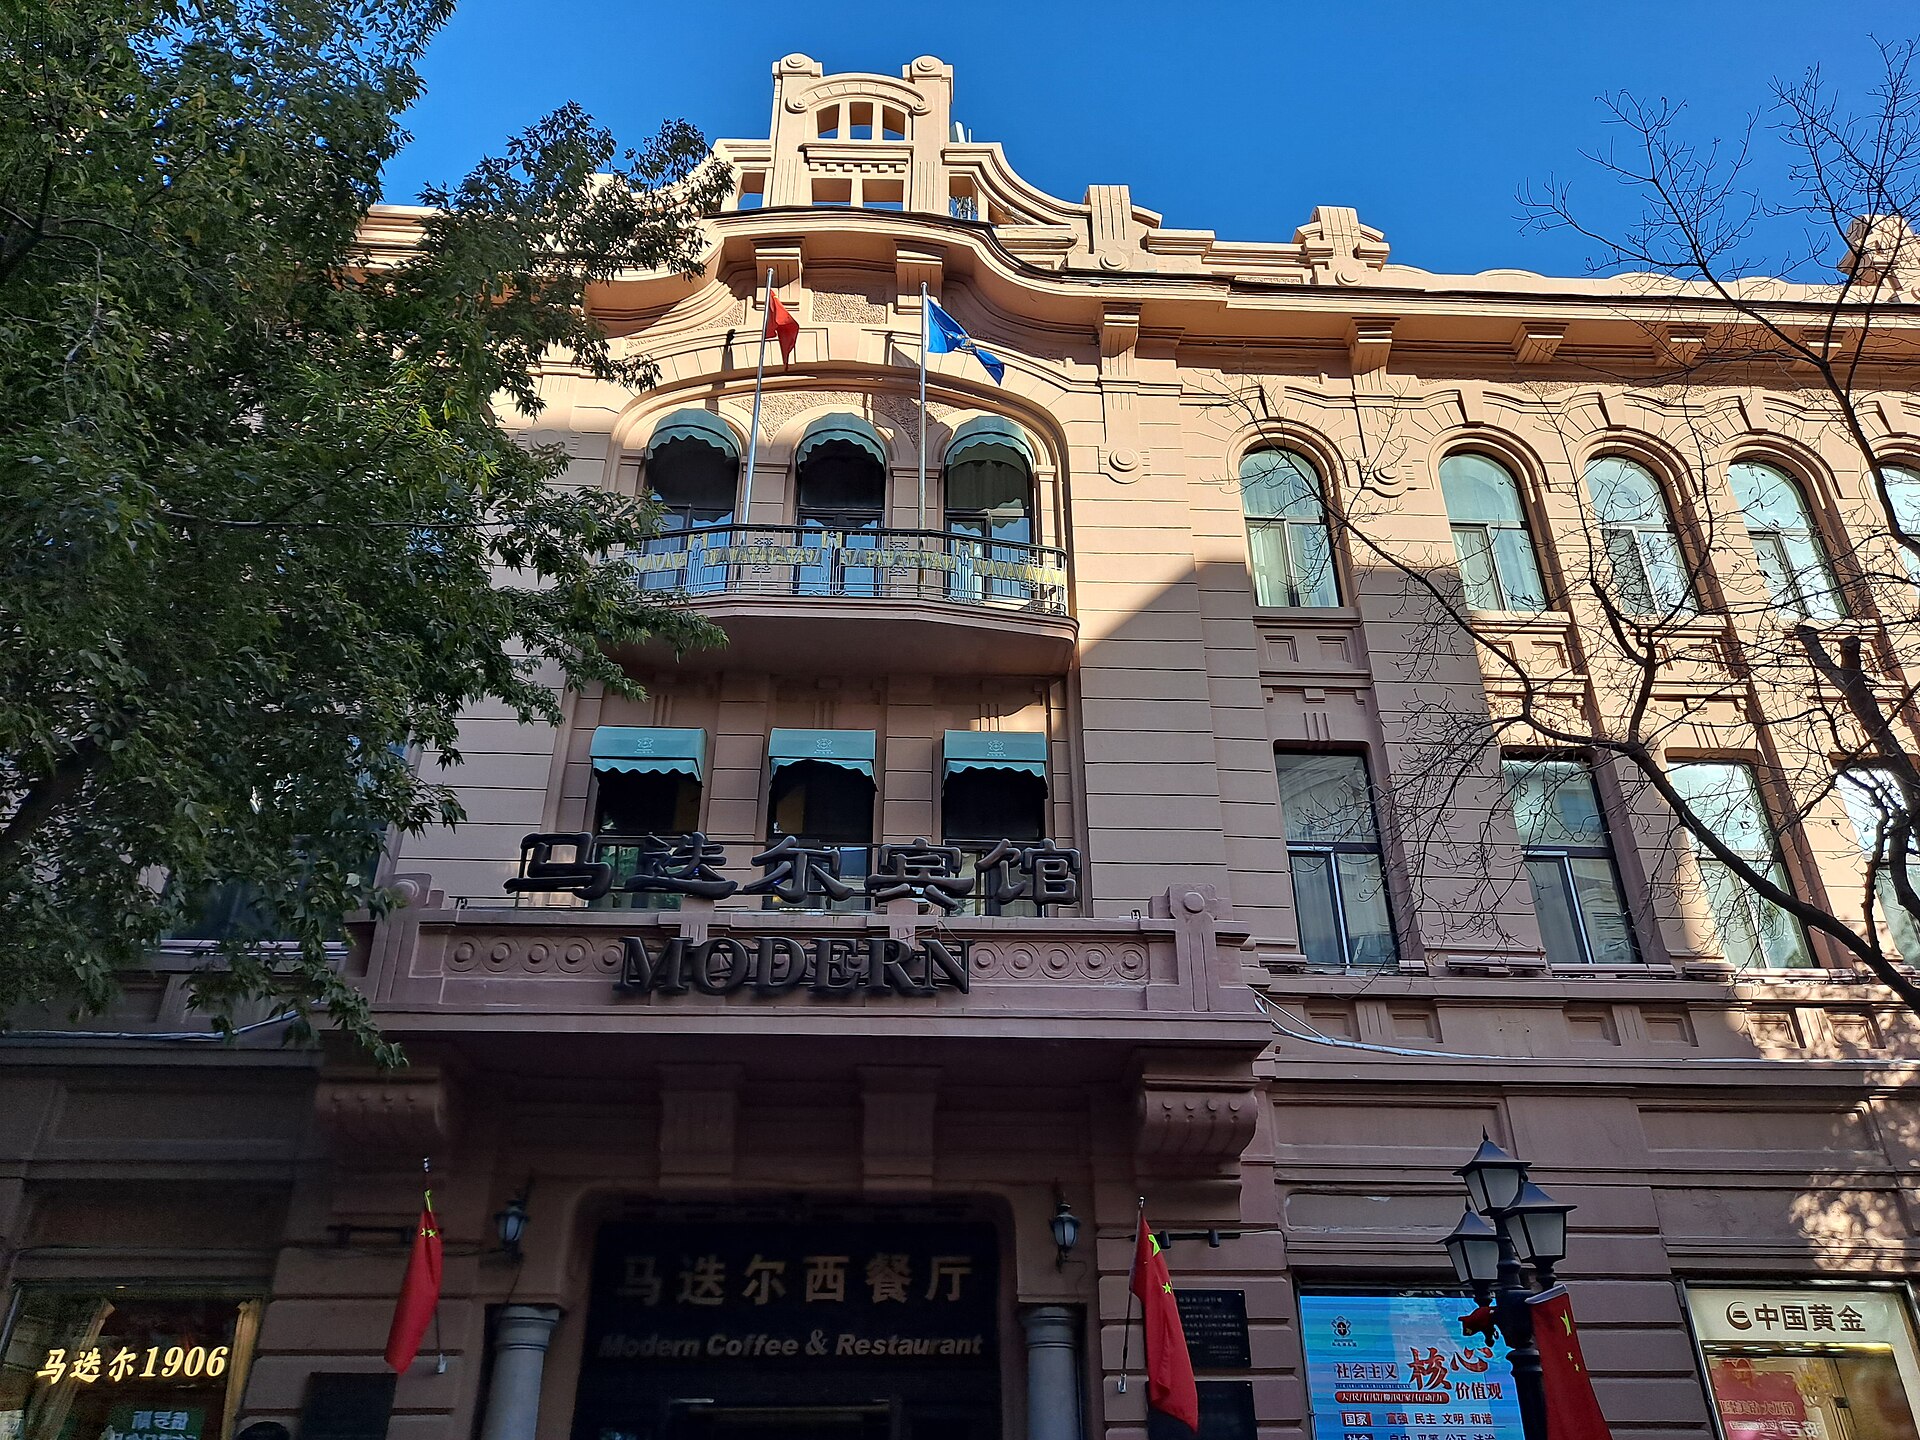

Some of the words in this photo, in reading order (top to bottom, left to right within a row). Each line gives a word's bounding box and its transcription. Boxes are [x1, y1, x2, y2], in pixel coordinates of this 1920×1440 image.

[503, 831, 1081, 911] 马迭尔宾馆
[614, 936, 973, 995] MODERN
[616, 1252, 973, 1306] 马迭尔西餐厅
[598, 1333, 700, 1357] Modern
[706, 1333, 798, 1356] Coffee
[805, 1328, 830, 1355] &
[836, 1333, 984, 1356] Restaurant
[1754, 1303, 1866, 1332] 中国黄金
[1336, 1363, 1398, 1379] 社会主义
[1407, 1346, 1494, 1391] 核心
[1455, 1381, 1504, 1400] 价值观
[1345, 1413, 1368, 1425] 国家
